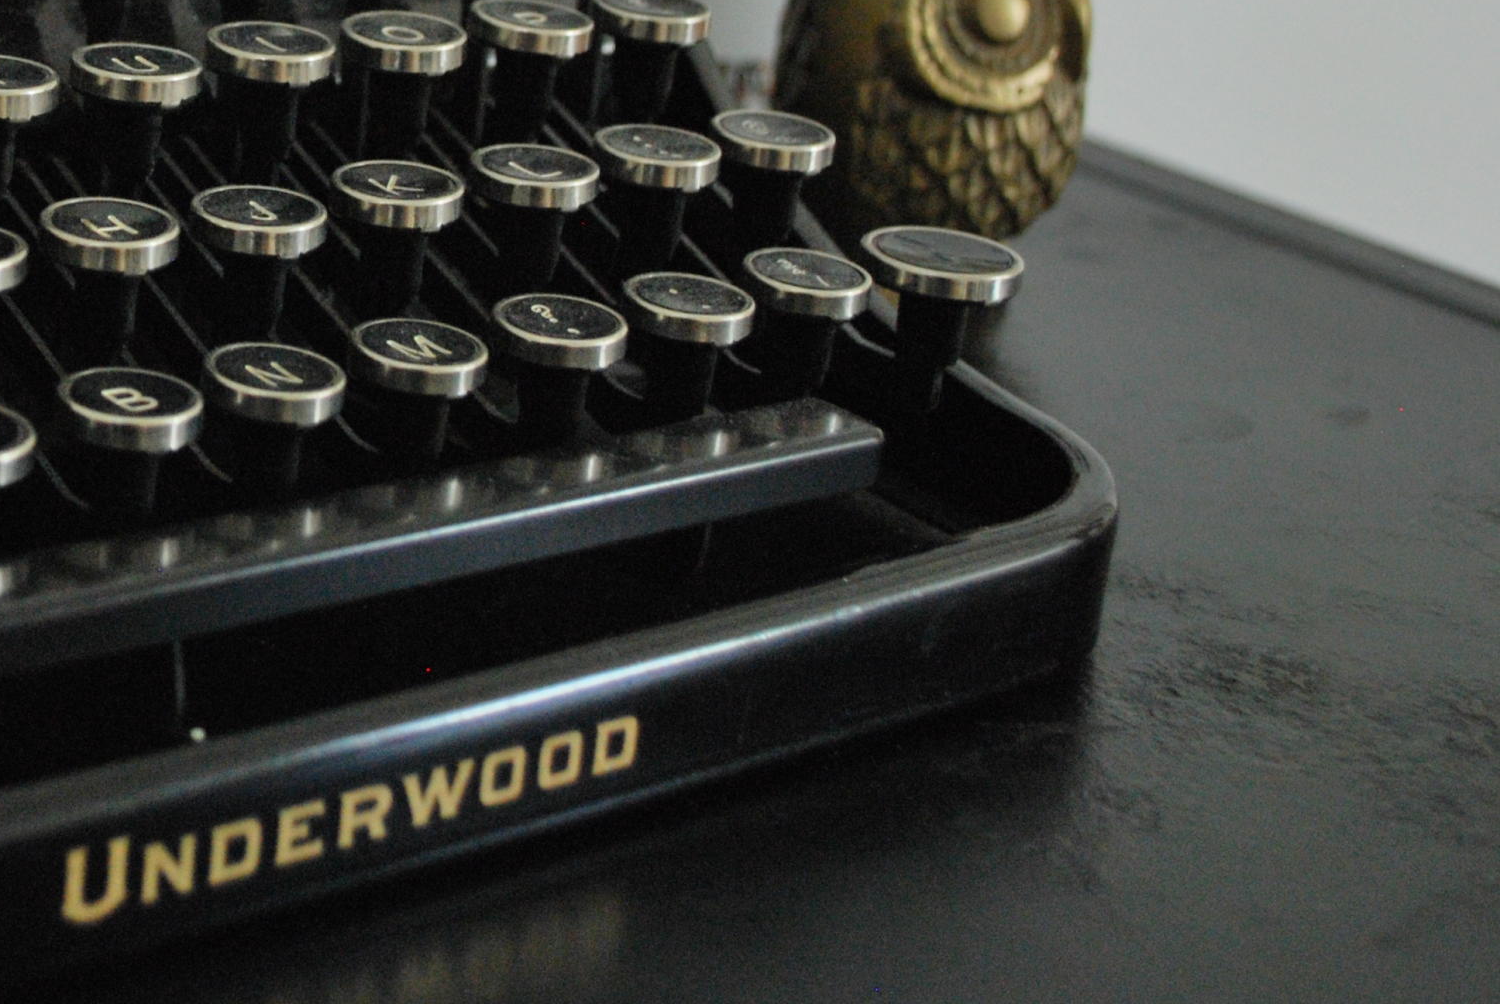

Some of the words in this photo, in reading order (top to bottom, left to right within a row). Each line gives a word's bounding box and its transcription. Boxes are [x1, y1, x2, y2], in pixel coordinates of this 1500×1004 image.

[381, 25, 424, 42] O
[110, 54, 161, 74] U
[508, 160, 562, 178] L
[367, 174, 424, 196] K
[247, 200, 278, 222] J
[81, 214, 138, 239] H
[386, 333, 452, 361] M
[243, 360, 304, 386] N
[99, 386, 158, 413] B
[61, 715, 641, 925] UNDERWOOD
